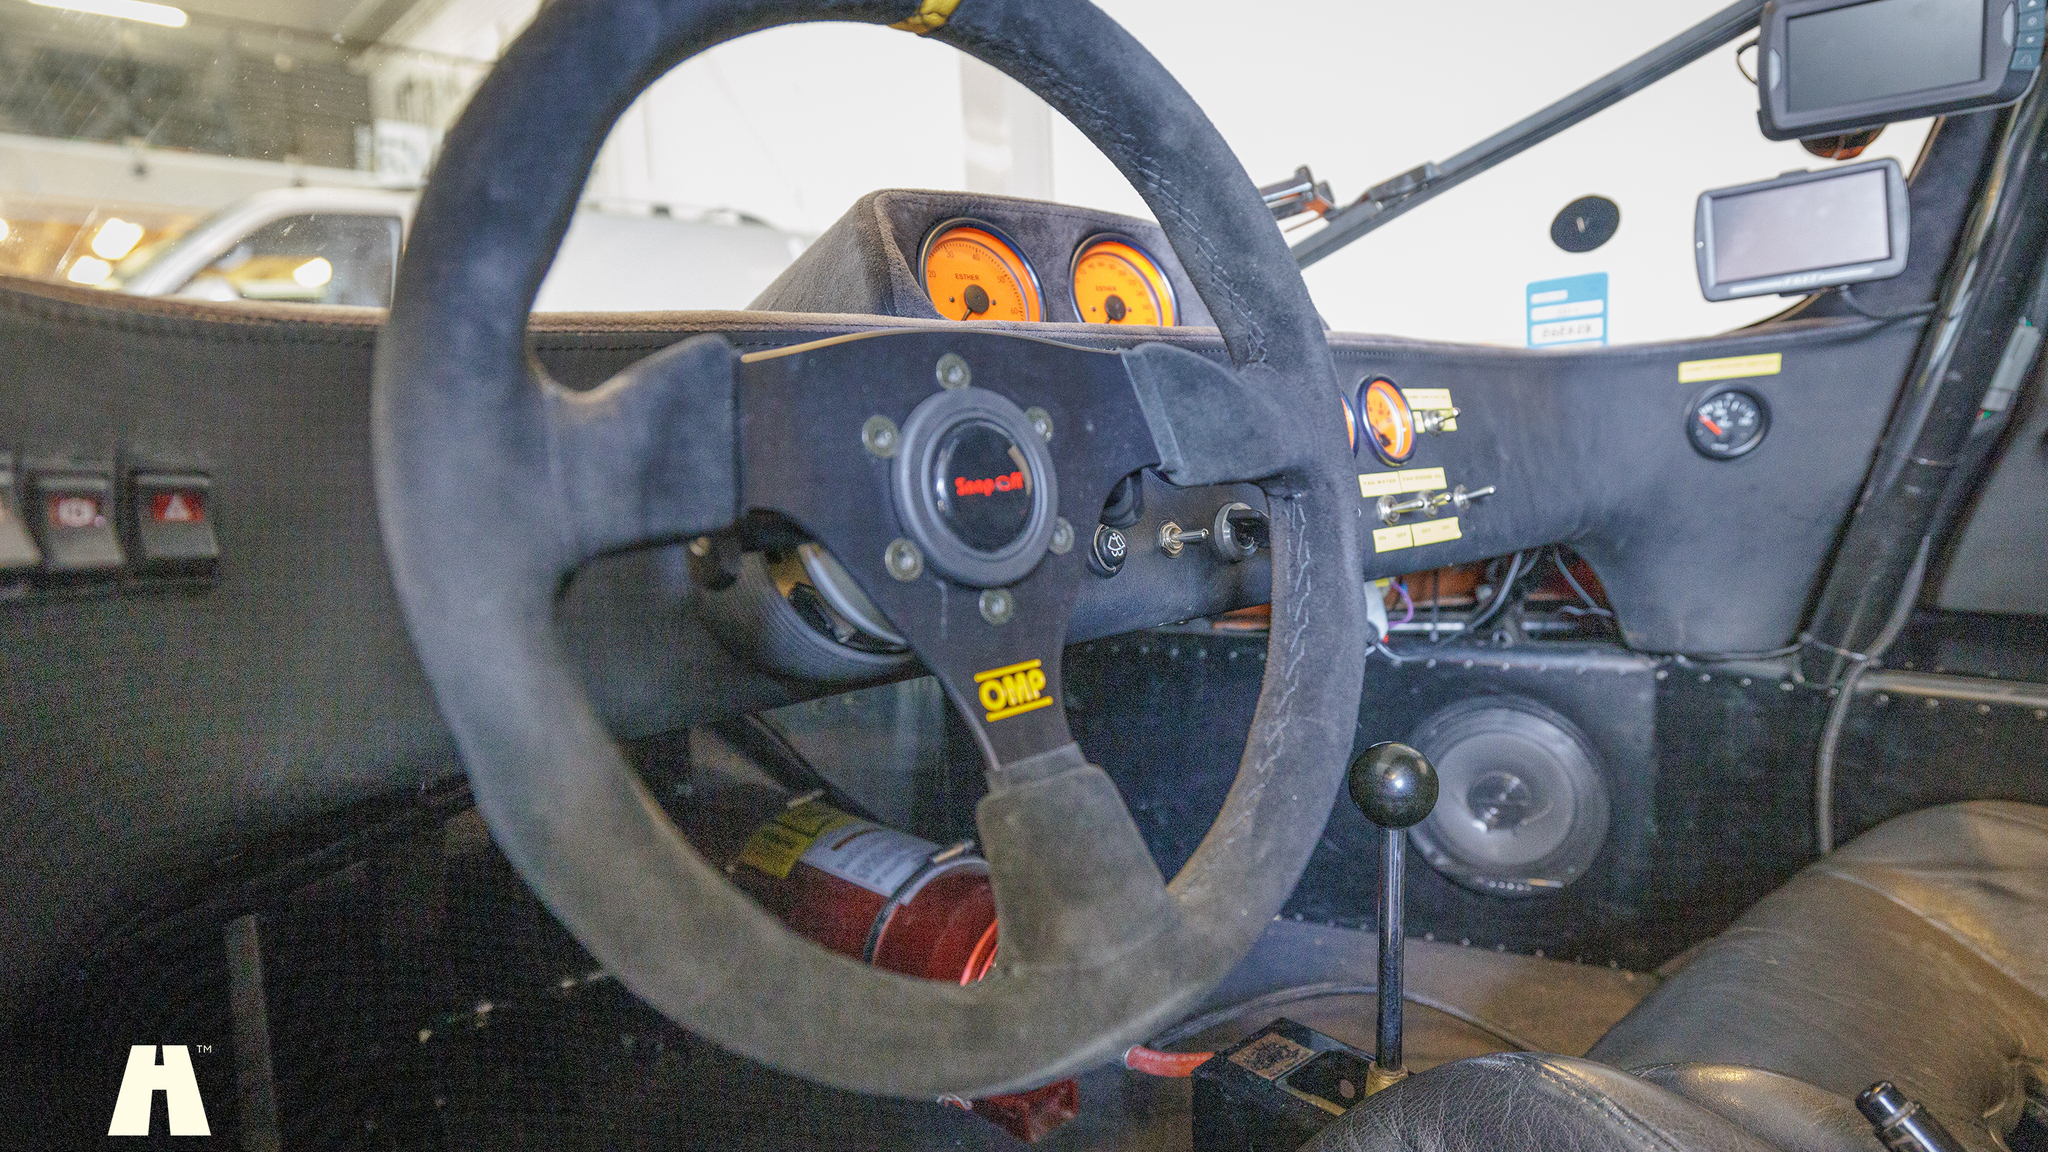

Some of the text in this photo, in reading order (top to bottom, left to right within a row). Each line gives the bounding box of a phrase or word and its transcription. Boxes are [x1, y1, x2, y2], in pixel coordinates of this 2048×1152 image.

[946, 250, 955, 259] 30
[972, 253, 980, 261] 40
[928, 269, 936, 278] 20
[955, 273, 980, 281] ESTHER
[997, 275, 1006, 284] 50
[1095, 284, 1118, 292] ESTHER
[1010, 307, 1019, 315] 60
[979, 668, 1046, 712] OMP
